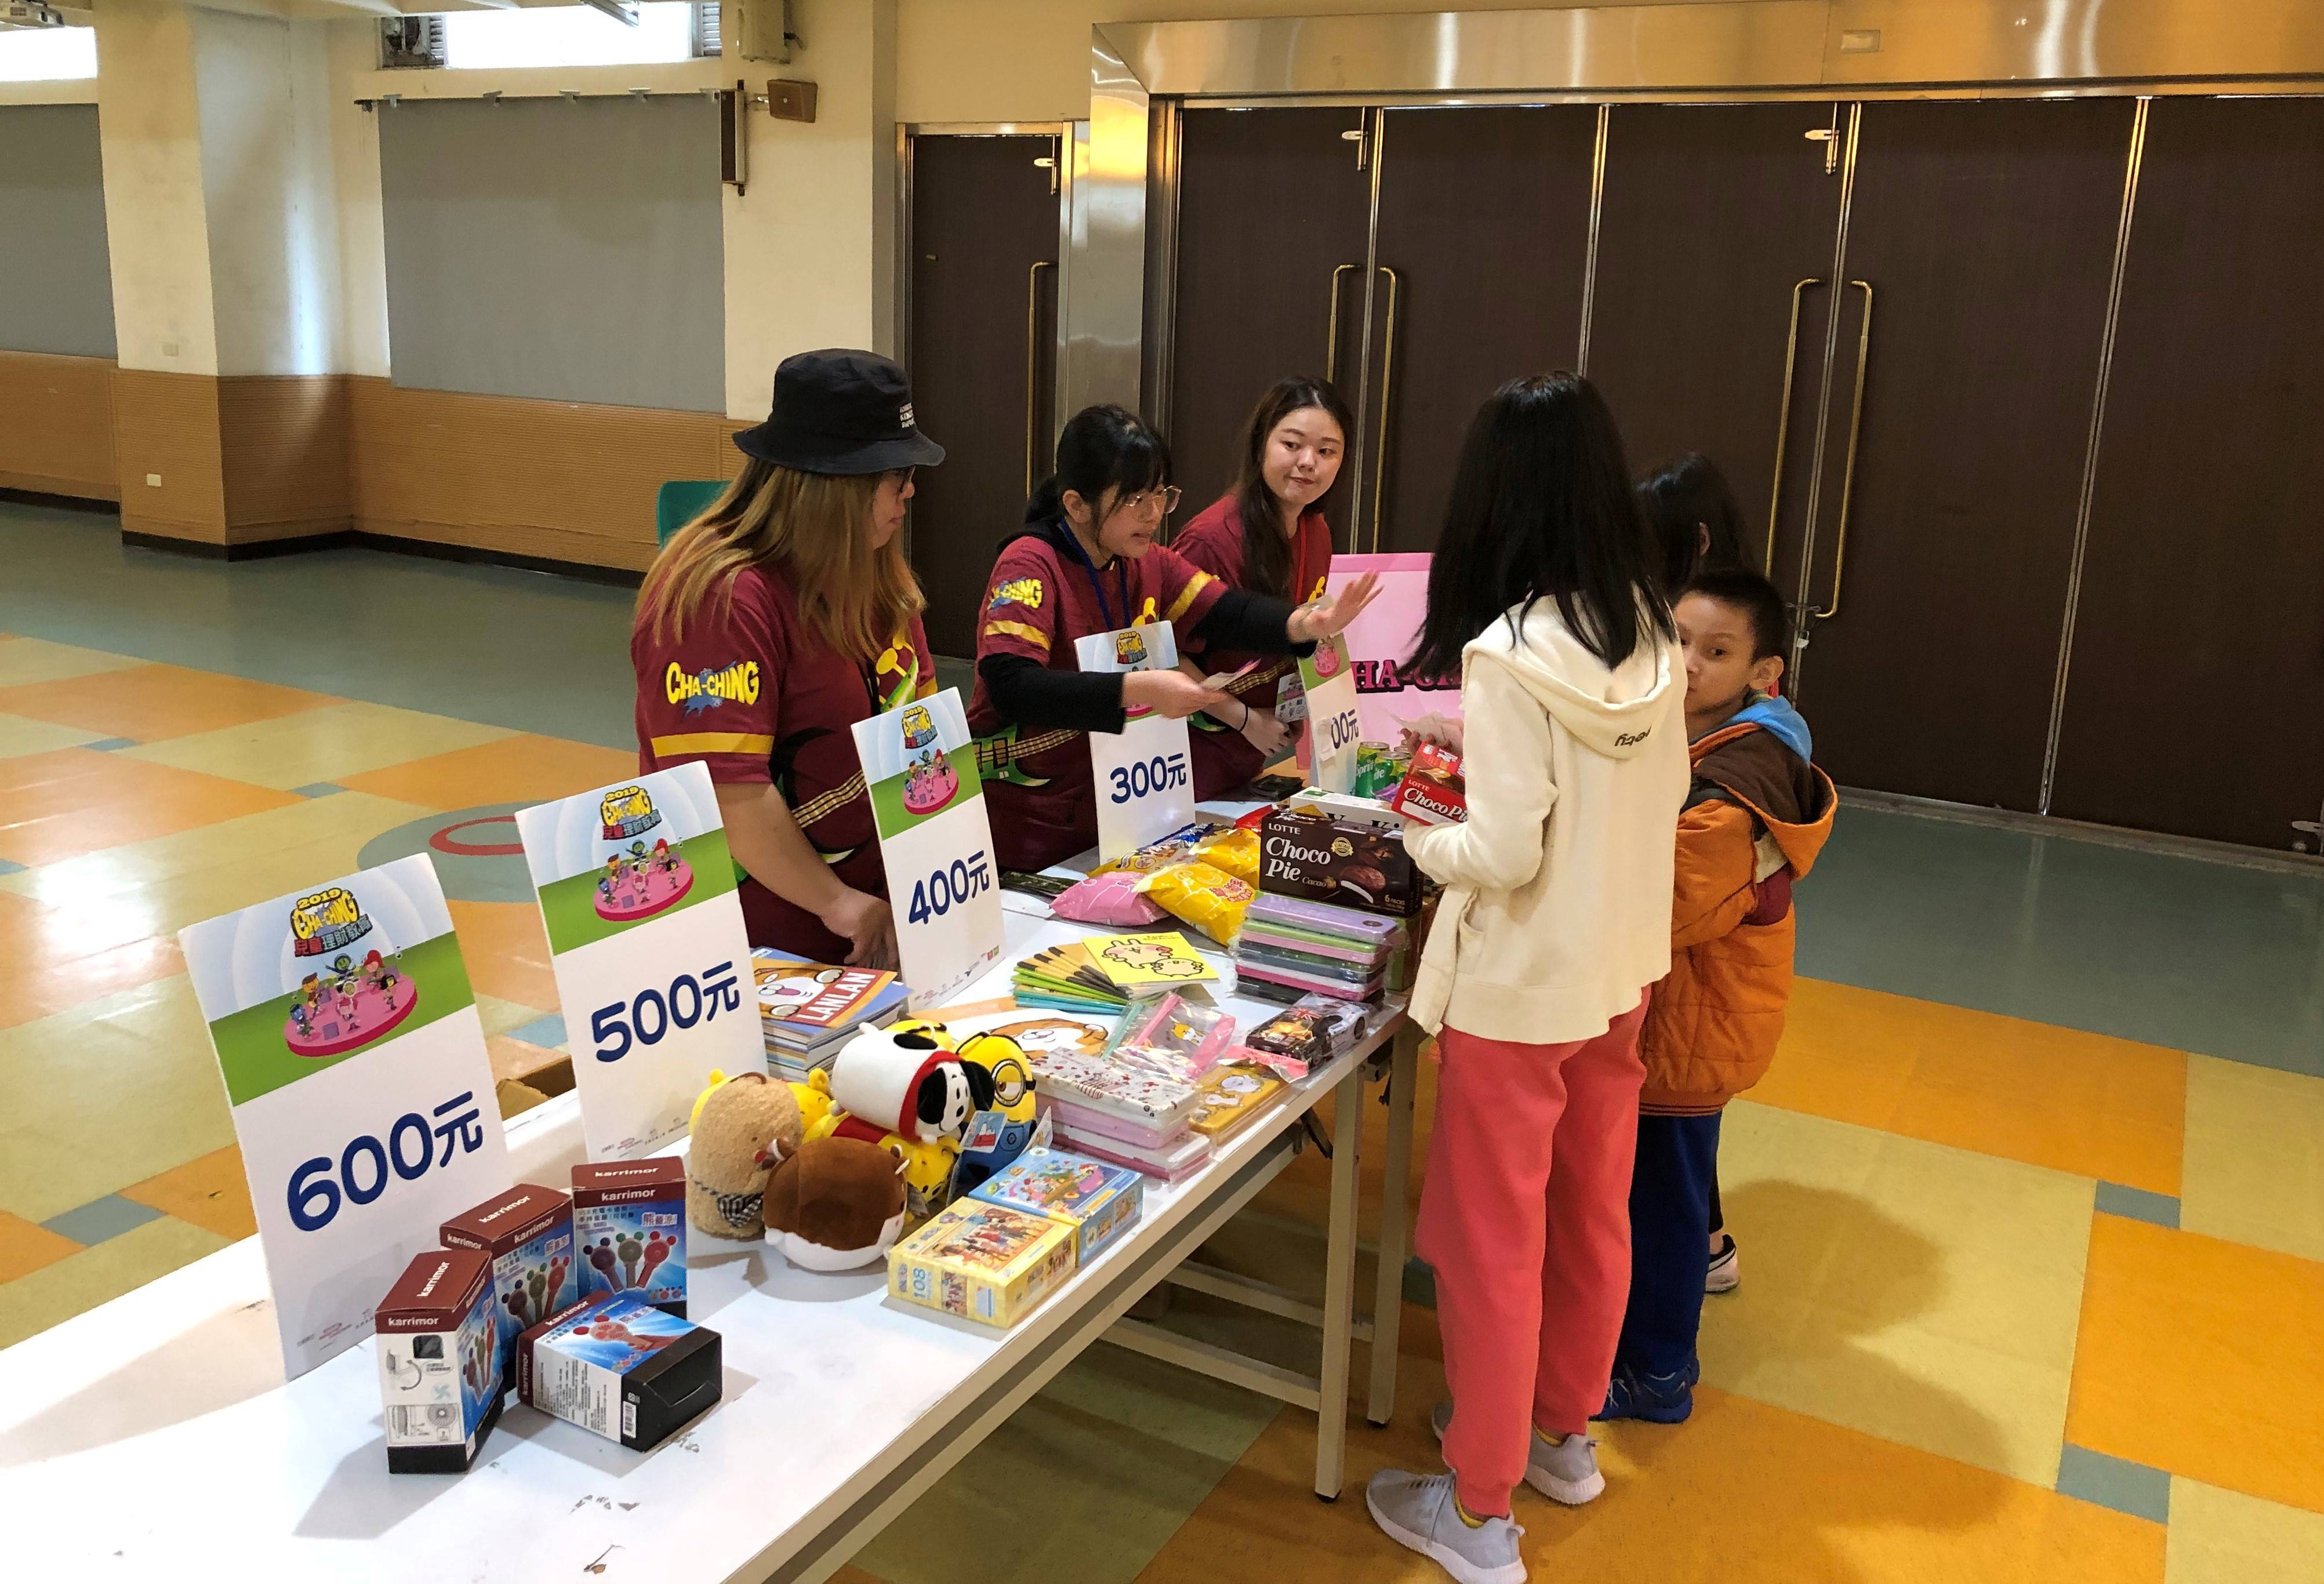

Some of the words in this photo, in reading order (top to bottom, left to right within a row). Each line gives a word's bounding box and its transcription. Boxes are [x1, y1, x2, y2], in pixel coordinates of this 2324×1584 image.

[666, 660, 760, 705] CHA-CHING
[1110, 753, 1186, 804] 300元
[1408, 779, 1430, 791] LOTTE
[606, 786, 640, 802] 2019
[1404, 787, 1448, 814] Choco
[1447, 804, 1468, 822] Pi
[1269, 823, 1301, 835] LOTTE
[1266, 837, 1331, 864] Choco
[1265, 858, 1301, 881] Pie
[1302, 876, 1327, 887] Cacao
[297, 888, 342, 910] 2019
[909, 849, 989, 925] 400元
[1385, 894, 1390, 902] 6
[796, 972, 876, 1022] LANLAN
[591, 960, 740, 1063] 500元
[287, 1090, 484, 1232] 600元
[595, 1167, 659, 1178] karrimor
[601, 1189, 656, 1201] karrimor
[478, 1196, 531, 1223] karrimor
[447, 1233, 482, 1249] karrimor
[514, 1216, 554, 1243] karrimor
[417, 1262, 450, 1297] karrimor
[913, 1267, 926, 1298] 108
[388, 1317, 440, 1327] karrimor
[545, 1300, 589, 1326] karrimor
